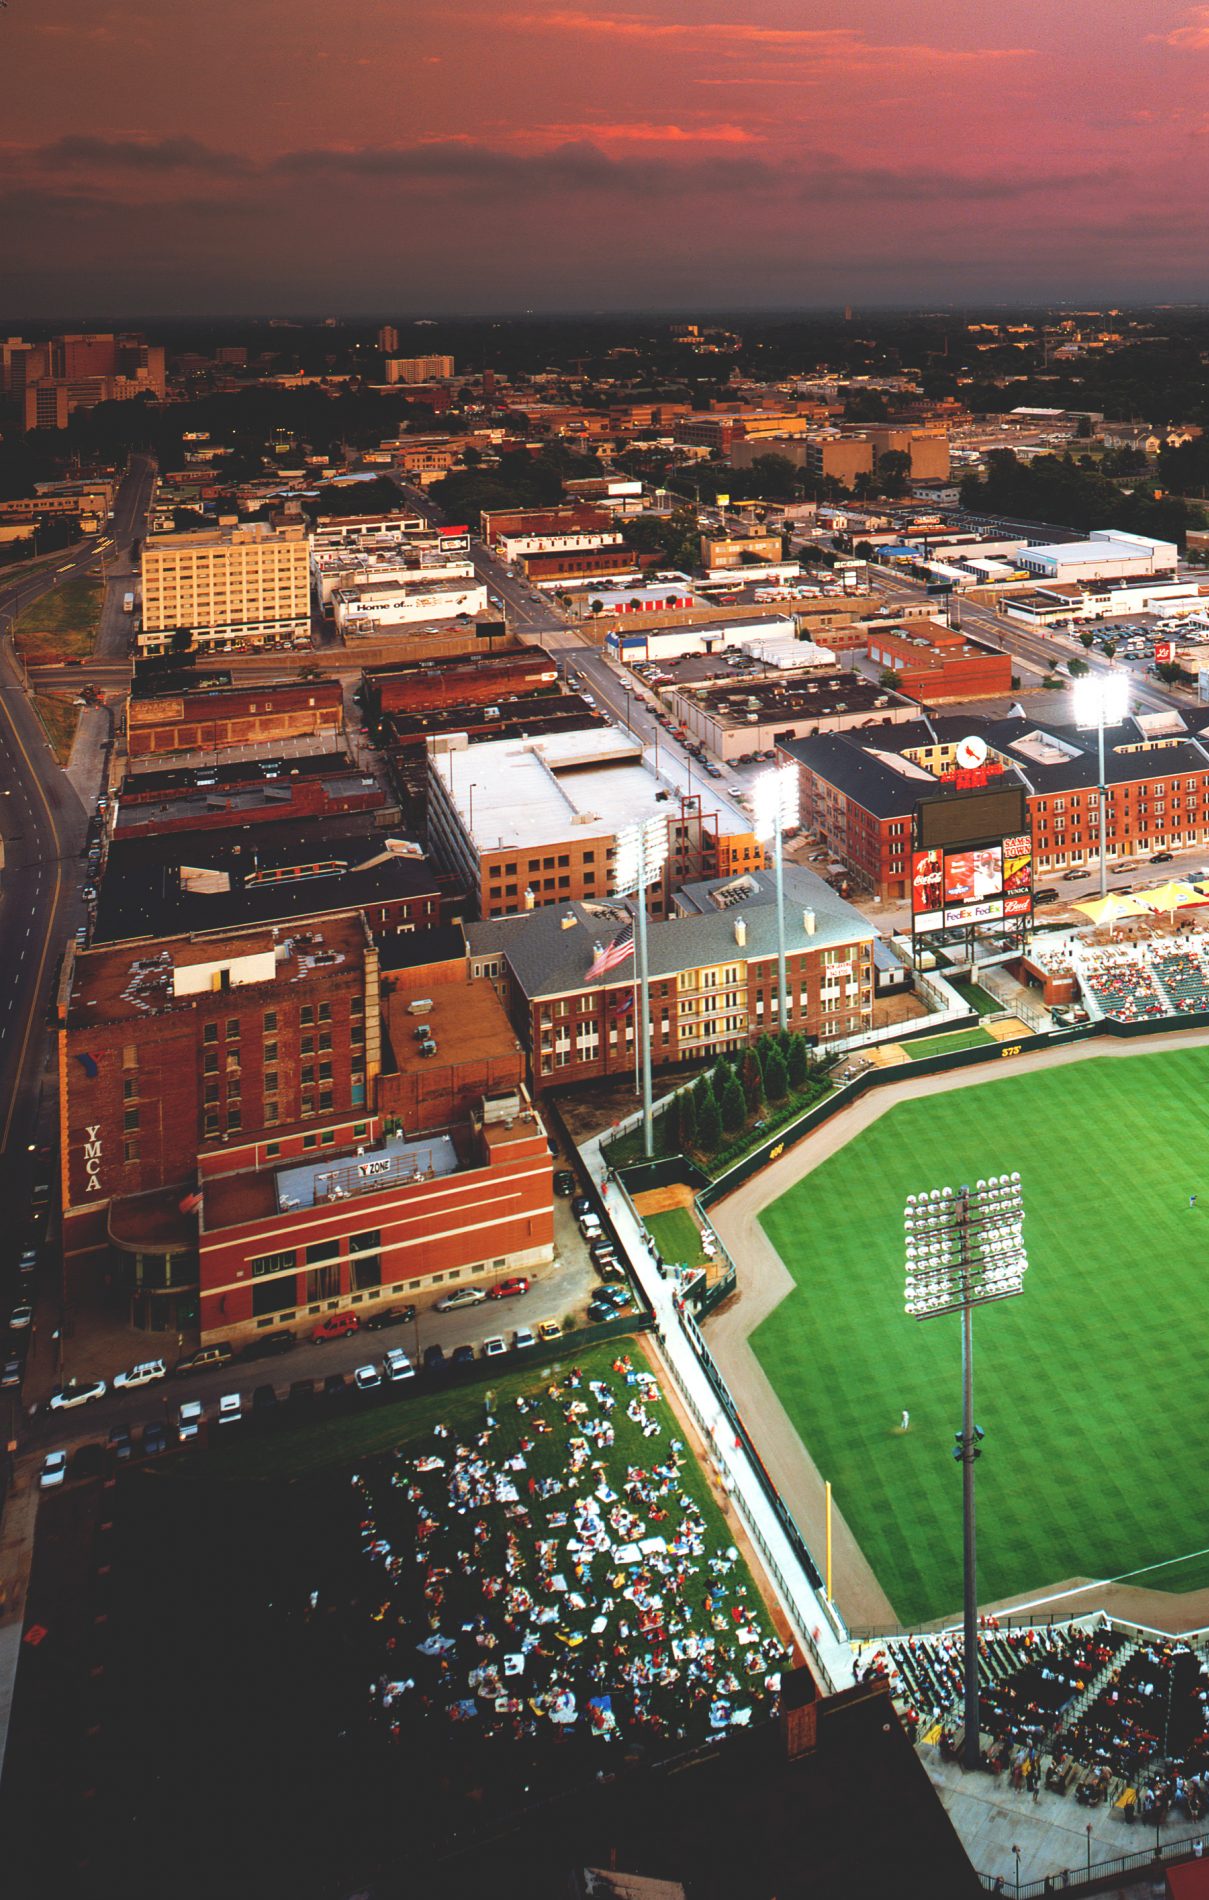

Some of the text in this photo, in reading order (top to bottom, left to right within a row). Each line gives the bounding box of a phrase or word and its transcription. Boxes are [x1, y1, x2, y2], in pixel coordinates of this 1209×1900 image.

[356, 603, 390, 612] Home
[1004, 845, 1031, 858] TOWN
[1007, 887, 1029, 895] TUNICA
[975, 904, 1000, 917] FedEx
[1004, 898, 1030, 913] Bud
[946, 910, 972, 921] FedEx
[84, 1125, 102, 1191] YMCA
[370, 1160, 389, 1174] ZONE
